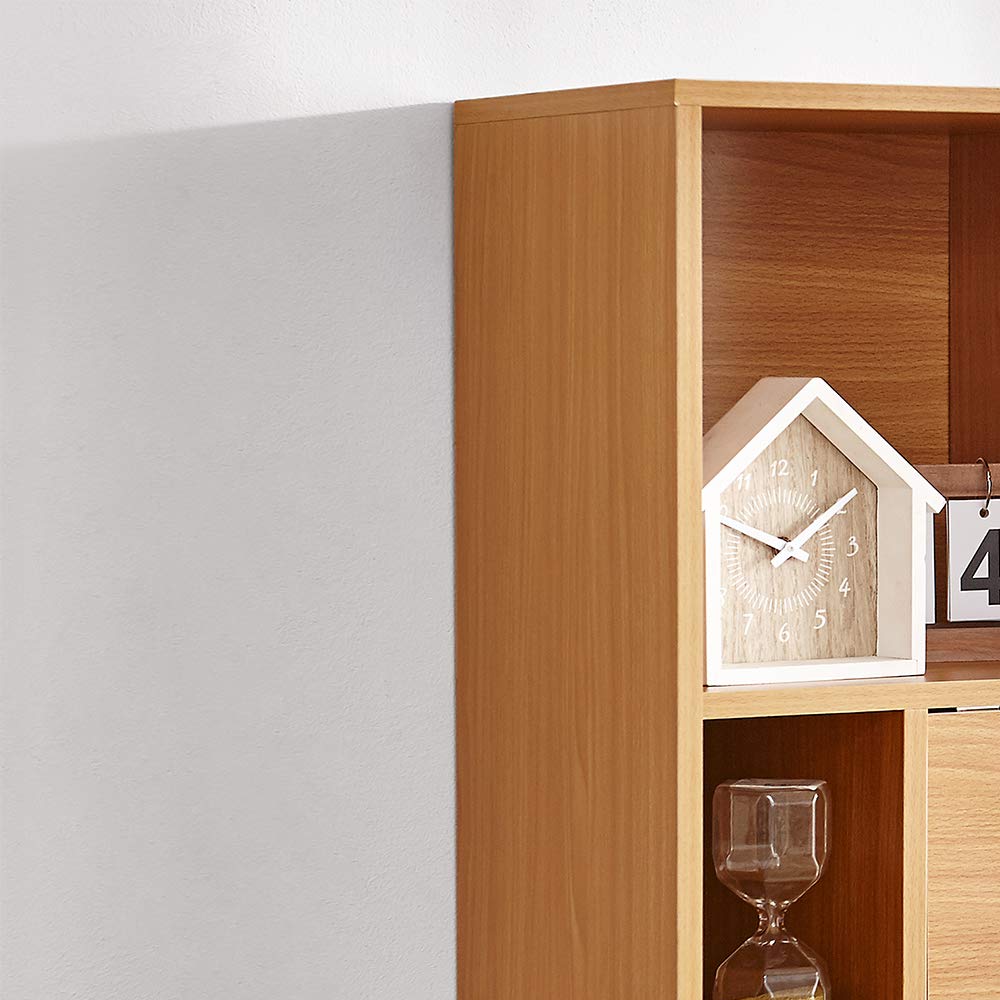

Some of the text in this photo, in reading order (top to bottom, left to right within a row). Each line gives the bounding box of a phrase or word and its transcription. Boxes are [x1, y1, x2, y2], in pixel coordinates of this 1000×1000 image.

[770, 458, 790, 477] 12
[810, 469, 818, 487] 1
[847, 536, 859, 557] 3
[838, 577, 851, 597] 4
[743, 613, 754, 635] 7
[814, 609, 827, 629] 5
[779, 622, 790, 642] 6
